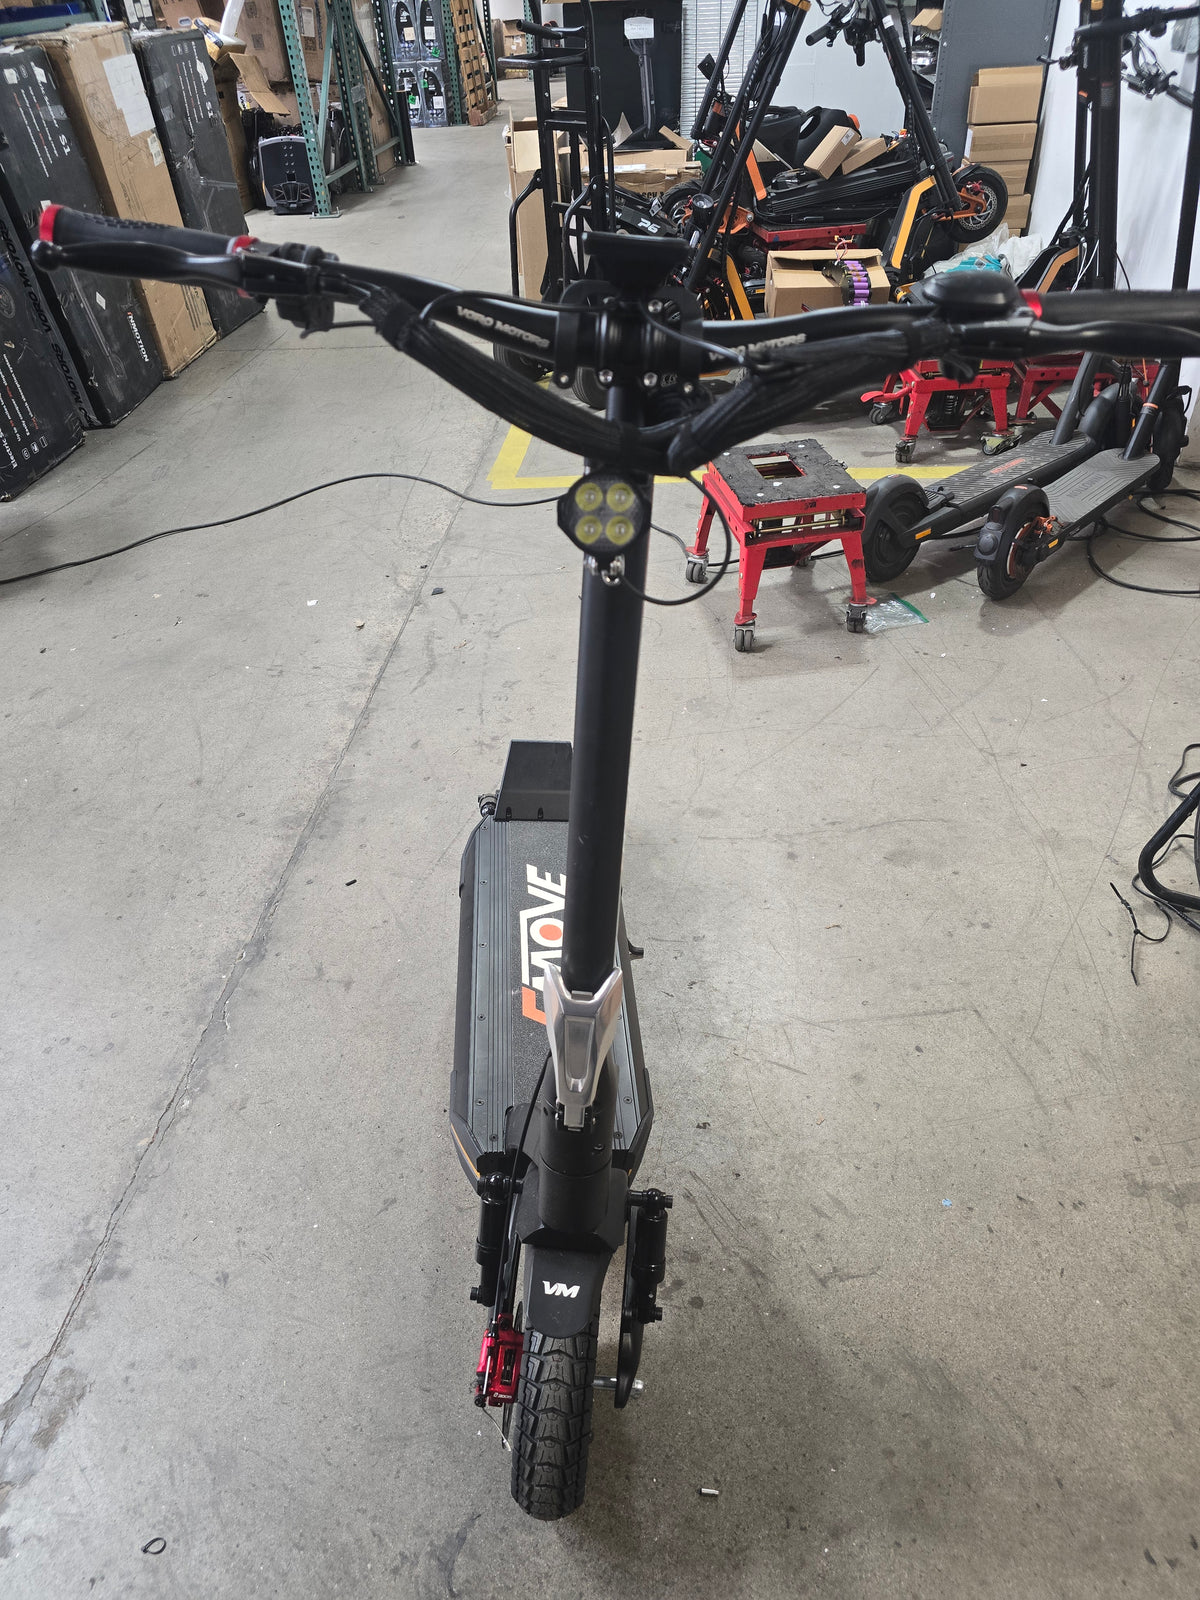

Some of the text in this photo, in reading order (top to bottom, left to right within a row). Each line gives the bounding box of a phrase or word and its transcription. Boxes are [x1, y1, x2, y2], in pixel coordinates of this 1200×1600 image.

[59, 134, 72, 155] S1
[637, 217, 660, 233] P6
[0, 219, 52, 334] VORO MOTORS
[456, 306, 550, 348] VORO MOTORS
[51, 343, 83, 404] MOTORS
[1, 438, 18, 468] Electric
[542, 1280, 580, 1298] VM
